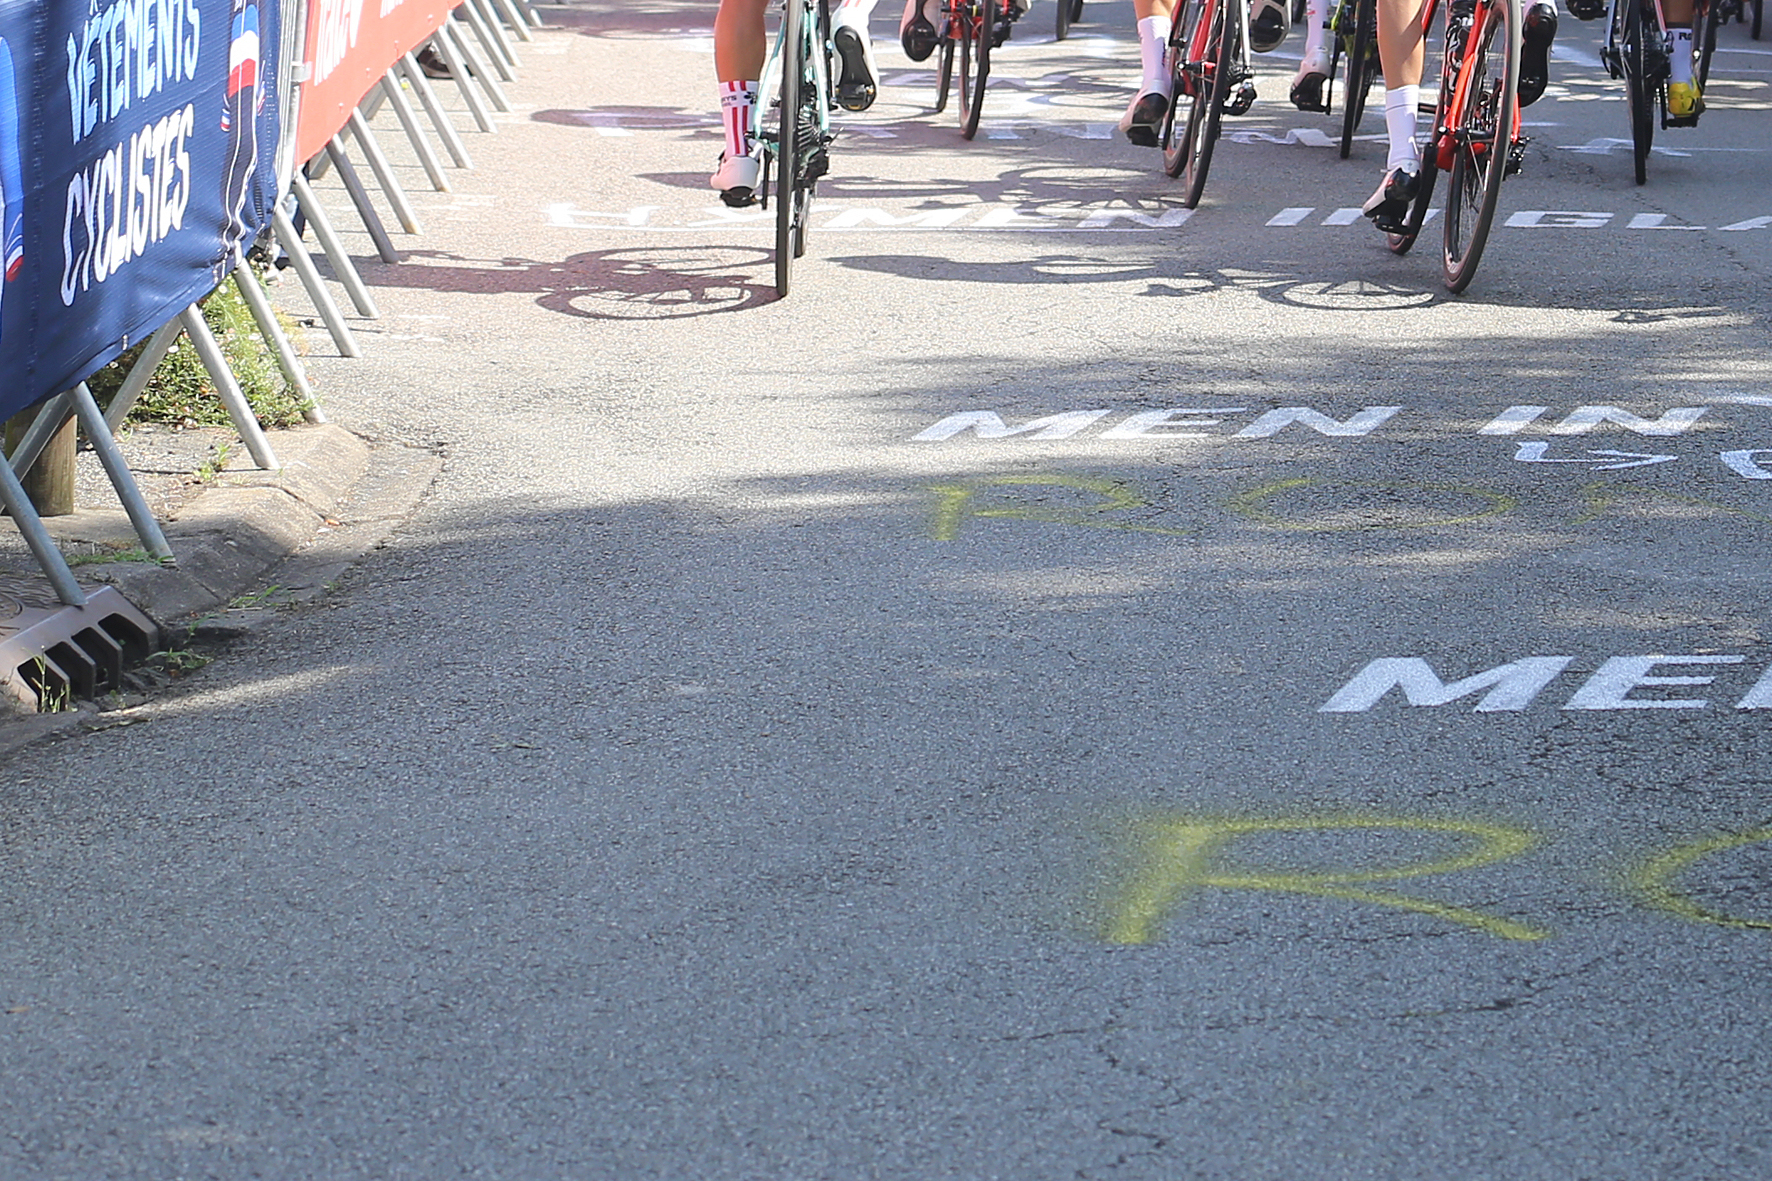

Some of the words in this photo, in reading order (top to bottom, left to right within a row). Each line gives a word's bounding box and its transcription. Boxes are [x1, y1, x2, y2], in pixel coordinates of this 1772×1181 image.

[61, 104, 193, 307] CYCLISTES
[910, 405, 1401, 443] MEN
[1477, 405, 1712, 438] IN
